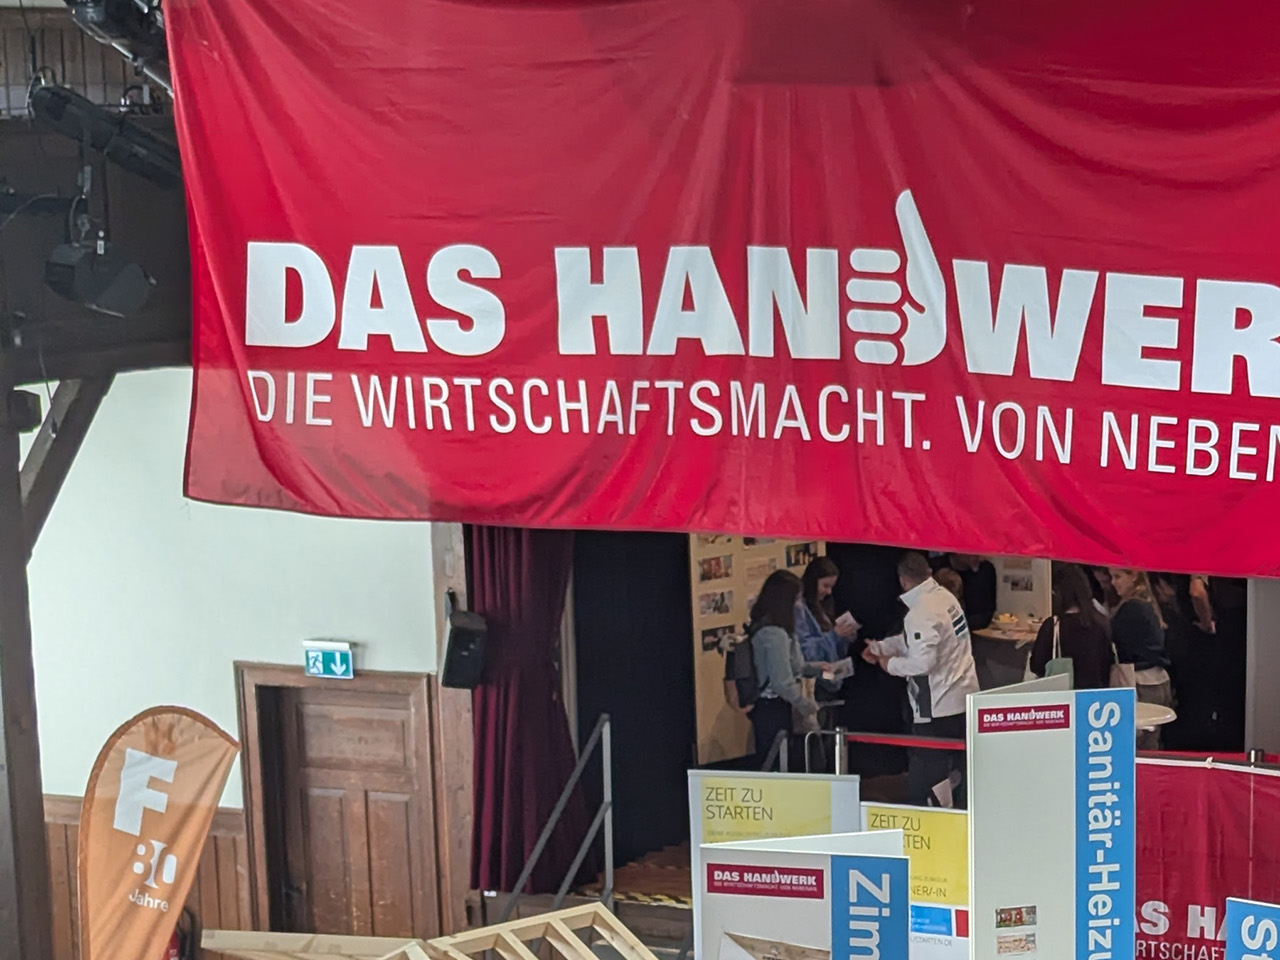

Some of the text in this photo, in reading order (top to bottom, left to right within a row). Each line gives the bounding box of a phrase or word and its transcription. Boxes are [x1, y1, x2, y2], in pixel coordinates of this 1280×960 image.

[245, 241, 506, 356] DAS
[247, 370, 333, 427] DIE
[351, 374, 931, 451] WIRTSCHAFTSMACHT.
[955, 396, 1075, 465] VON
[983, 714, 1004, 723] DAS
[113, 748, 178, 836] F
[705, 787, 763, 802] ZEIT ZU
[705, 805, 773, 821] STARTEN
[870, 814, 921, 831] ZEIT ZU
[714, 869, 816, 885] DAS HANDWERK
[129, 893, 169, 912] Jahre
